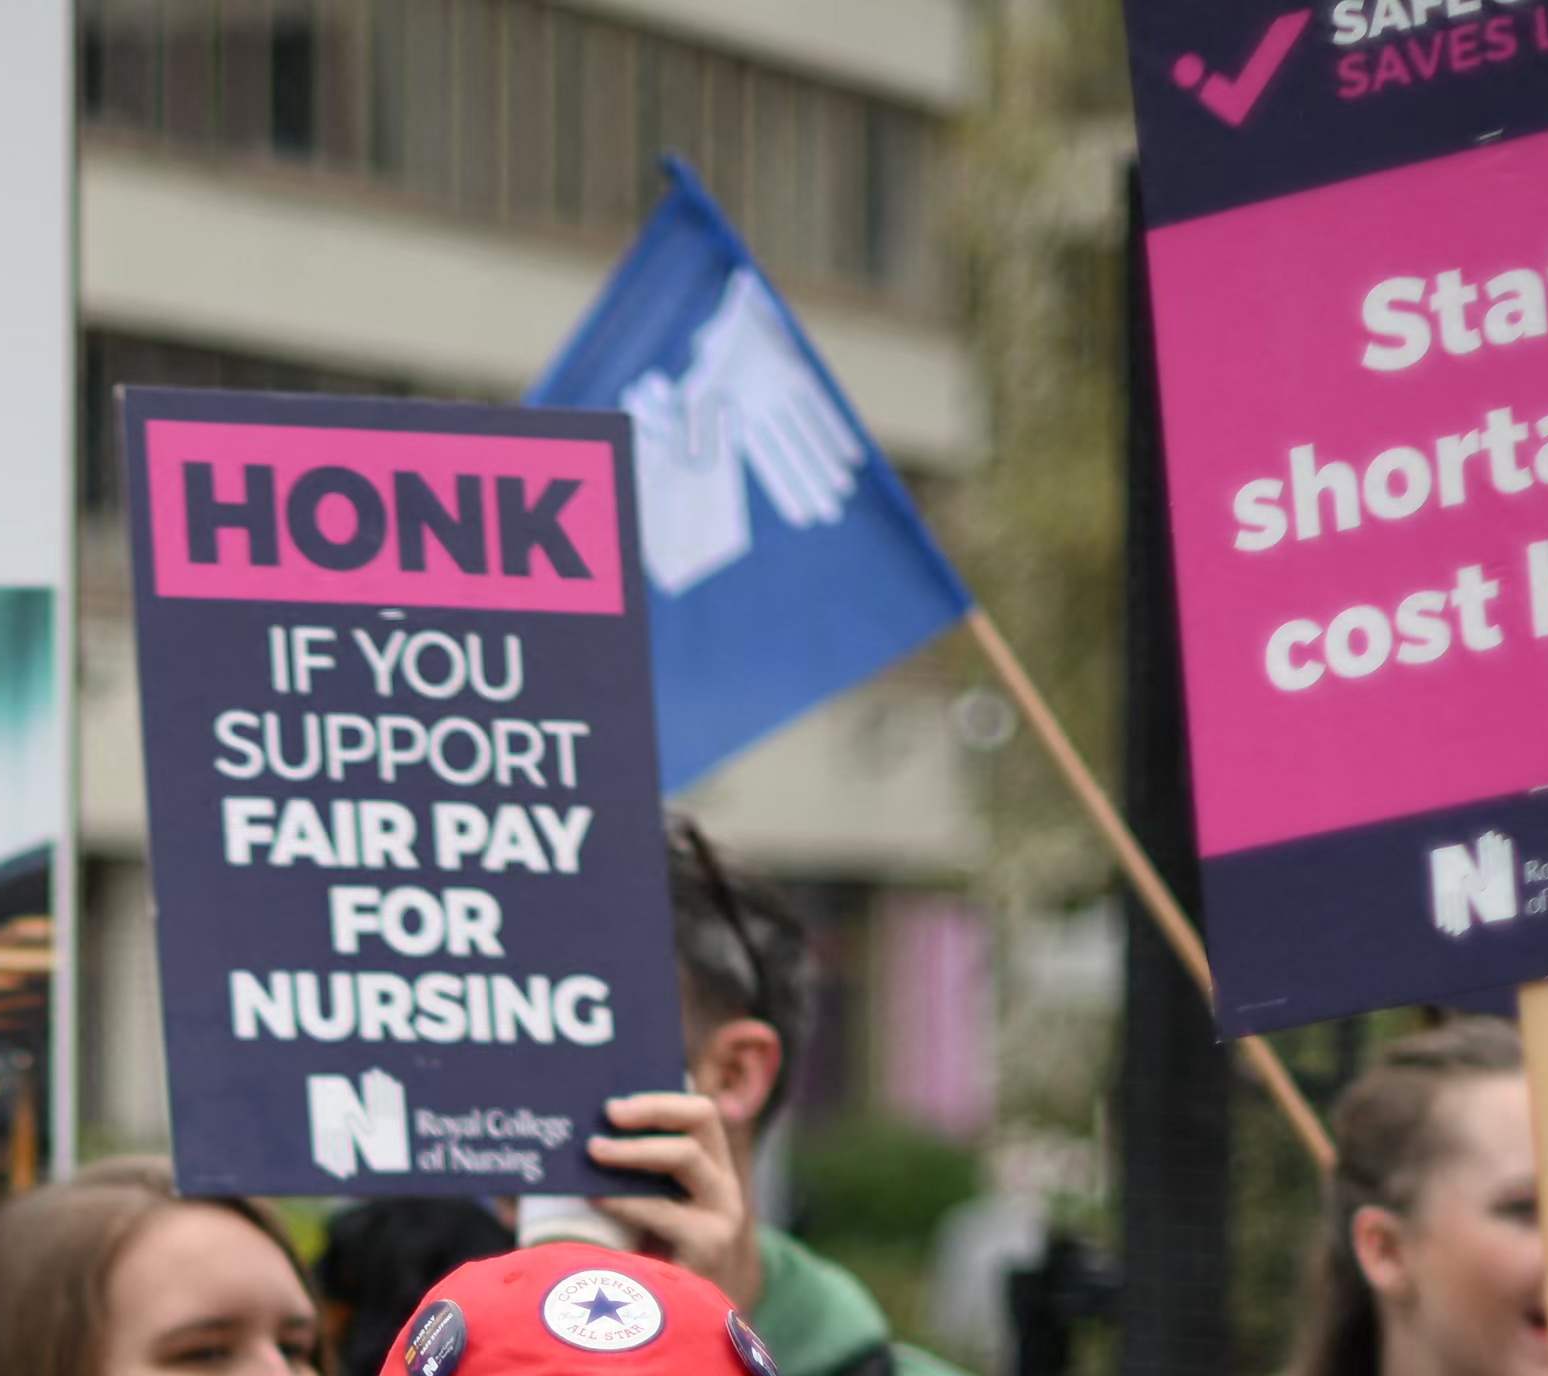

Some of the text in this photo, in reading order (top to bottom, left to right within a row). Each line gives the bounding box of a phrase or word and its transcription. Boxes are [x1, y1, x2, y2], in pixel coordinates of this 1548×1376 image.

[1337, 16, 1518, 98] SAVES
[182, 461, 595, 581] HONK
[270, 625, 522, 702] IF YOU
[1264, 563, 1505, 693] cost
[214, 709, 590, 788] SUPPORT
[222, 797, 594, 874] FAIR PAY
[329, 885, 506, 958] FOR
[229, 969, 615, 1046] NURSING
[415, 1108, 573, 1147] Royal College
[417, 1142, 545, 1184] of Nursing
[559, 1276, 644, 1302] CONVERSE
[567, 1323, 645, 1341] ALL STAR
